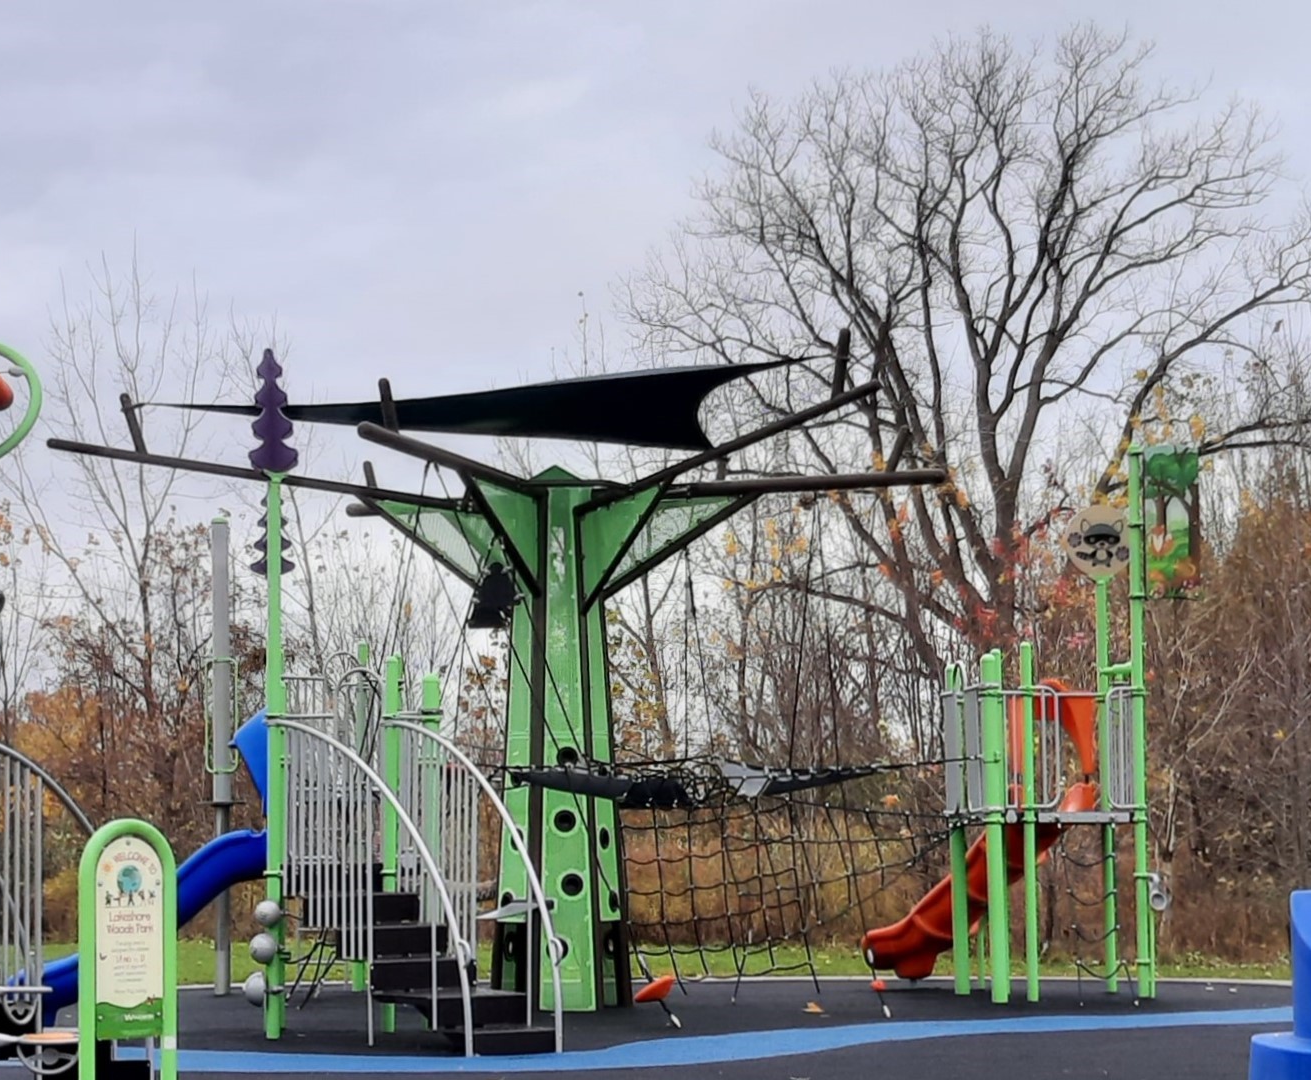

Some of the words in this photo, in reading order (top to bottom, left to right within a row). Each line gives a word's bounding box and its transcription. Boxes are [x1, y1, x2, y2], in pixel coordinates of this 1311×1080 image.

[113, 851, 150, 866] WELCOME
[108, 910, 151, 922] Lakeshore
[107, 924, 135, 934] Woods
[135, 923, 154, 934] Park
